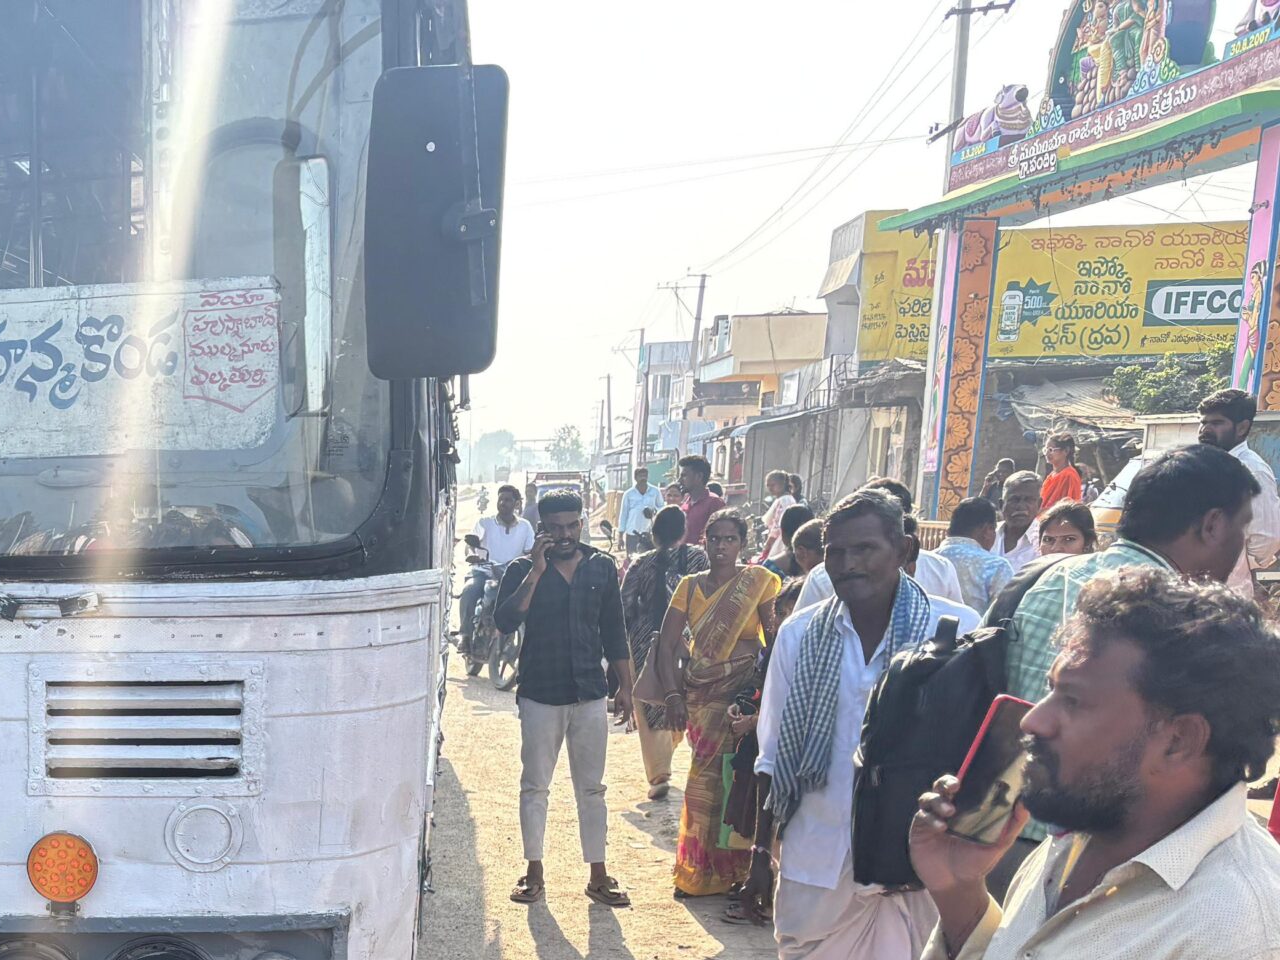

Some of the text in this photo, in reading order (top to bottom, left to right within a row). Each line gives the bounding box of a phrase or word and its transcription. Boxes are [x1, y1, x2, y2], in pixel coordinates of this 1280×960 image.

[1160, 226, 1248, 247] యూరియ
[1077, 256, 1128, 279] ఇఫ్కో
[1154, 248, 1205, 270] నానో
[1074, 277, 1132, 296] నానో
[898, 297, 932, 317] ఫర్టిలై
[1024, 295, 1043, 309] 500
[1055, 296, 1140, 321] యూరియా
[1163, 289, 1244, 314] IFFCO
[895, 323, 930, 342] పెస్టిసై
